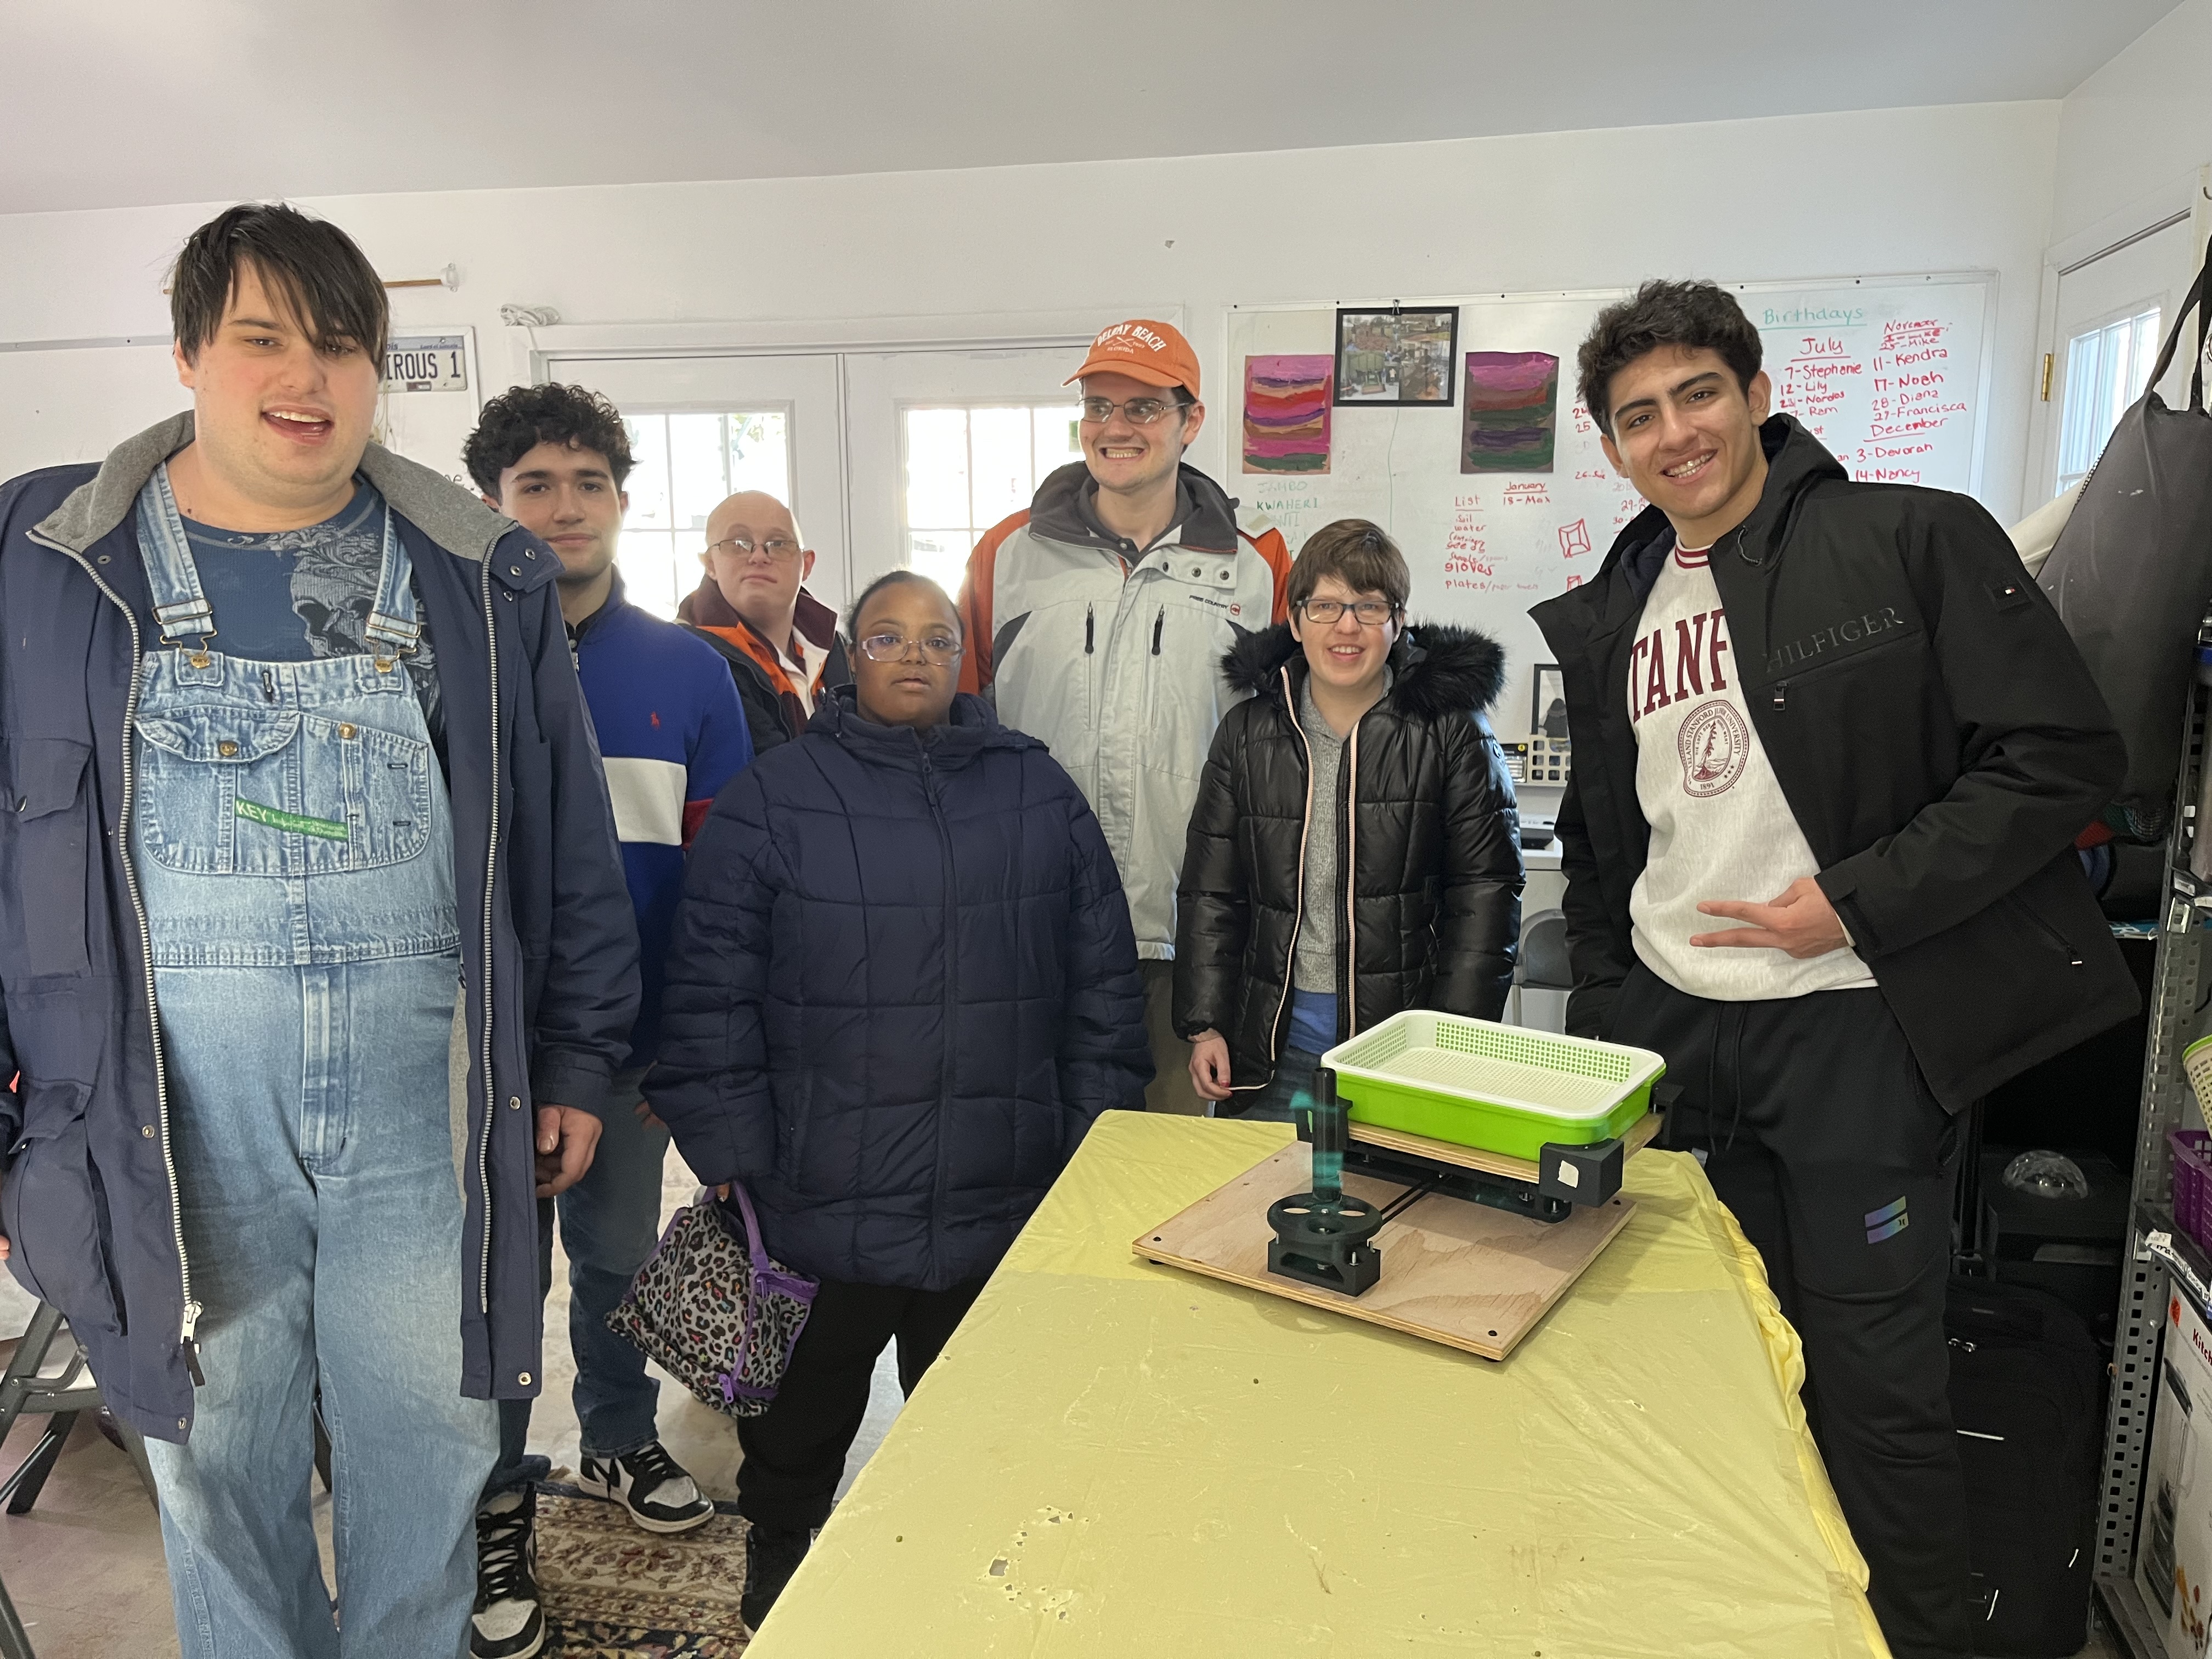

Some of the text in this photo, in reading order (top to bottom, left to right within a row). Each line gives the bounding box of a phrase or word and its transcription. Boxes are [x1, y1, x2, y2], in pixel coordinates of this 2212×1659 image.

[1763, 308, 1864, 325] Birthdays
[1132, 325, 1167, 352] BEACH
[1799, 337, 1843, 354] July
[386, 351, 460, 380] IROUS 1
[1870, 417, 1949, 437] December
[1505, 482, 1547, 493] January
[1256, 497, 1318, 511] KWAHERI
[1455, 495, 1480, 507] List
[1444, 561, 1495, 577] gloves
[1204, 599, 1229, 609] COUNTRY
[1762, 607, 1905, 673] HILFIGER
[1632, 608, 1728, 725] TANF
[1686, 709, 1713, 739] STANFORD
[1725, 713, 1741, 756] UNIVERSITY
[236, 800, 268, 822] KEY
